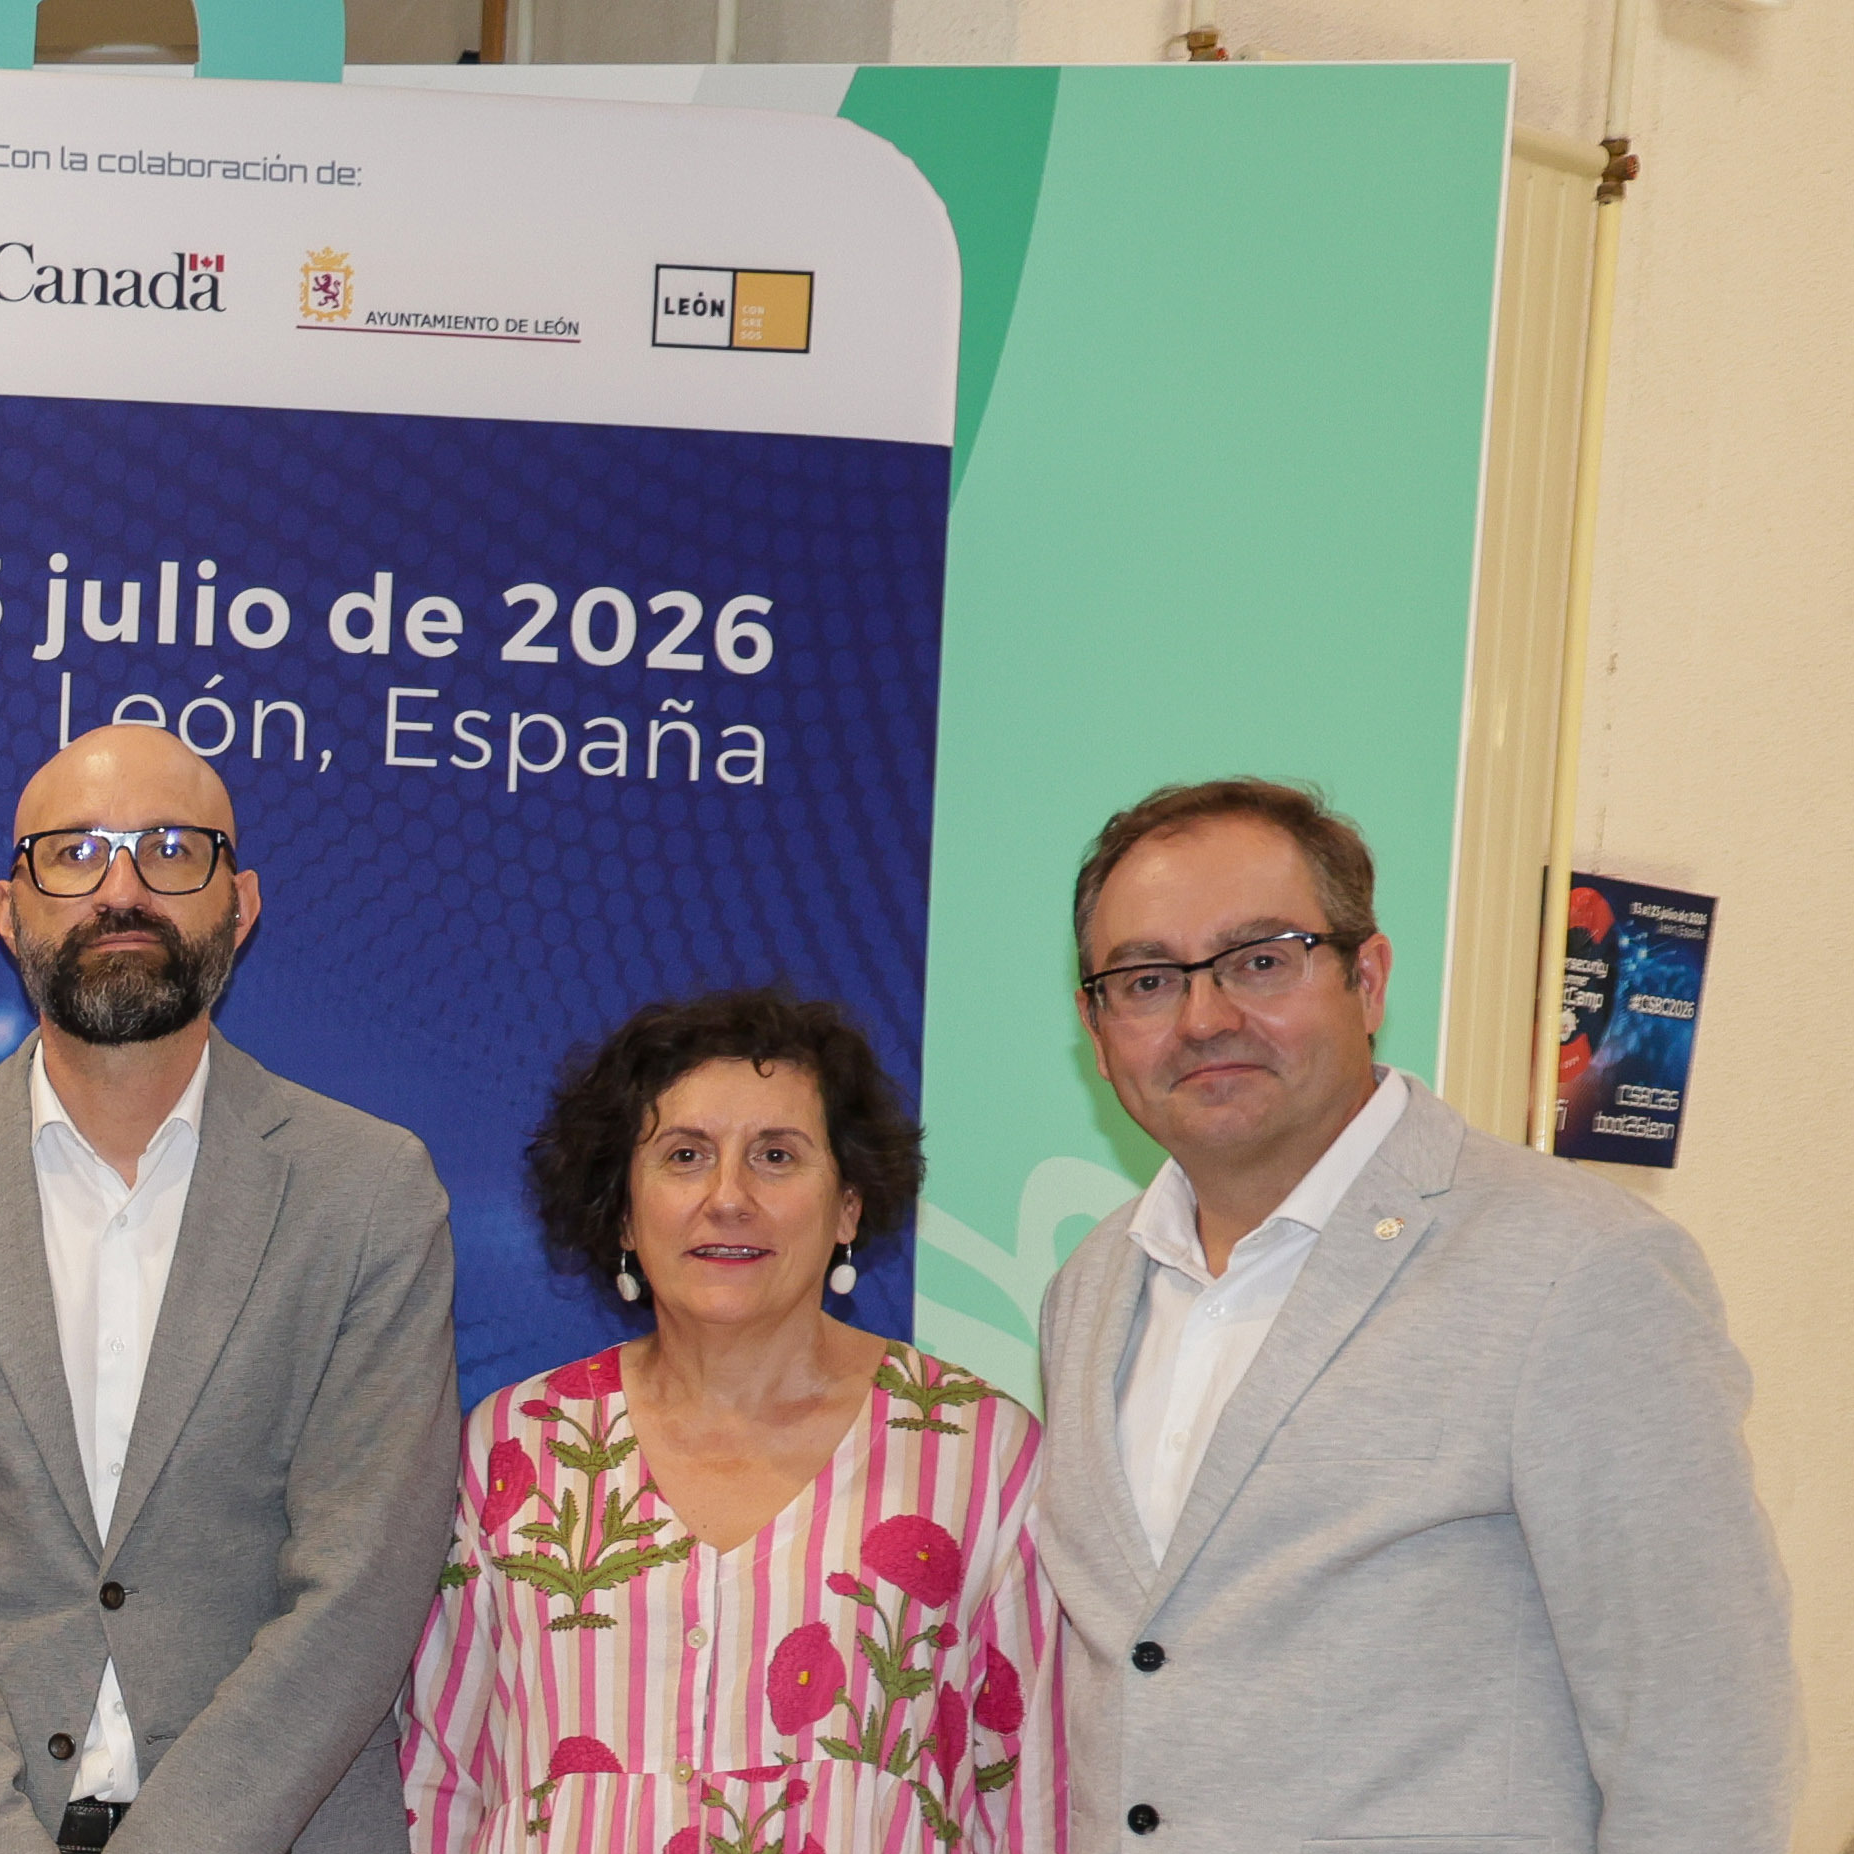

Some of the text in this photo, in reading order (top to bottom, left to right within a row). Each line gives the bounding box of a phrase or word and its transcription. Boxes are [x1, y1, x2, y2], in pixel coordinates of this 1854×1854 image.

[60, 145, 89, 172] la
[97, 149, 309, 184] colaboración
[315, 160, 363, 187] de:
[663, 291, 726, 318] LEÓN
[365, 311, 580, 336] AYUNTAMIENTO DE LEÓN
[31, 552, 292, 662] julio
[328, 570, 465, 658] de
[500, 581, 775, 676] 2026
[383, 685, 769, 793] España
[1629, 993, 1696, 1021] #CSBC2026
